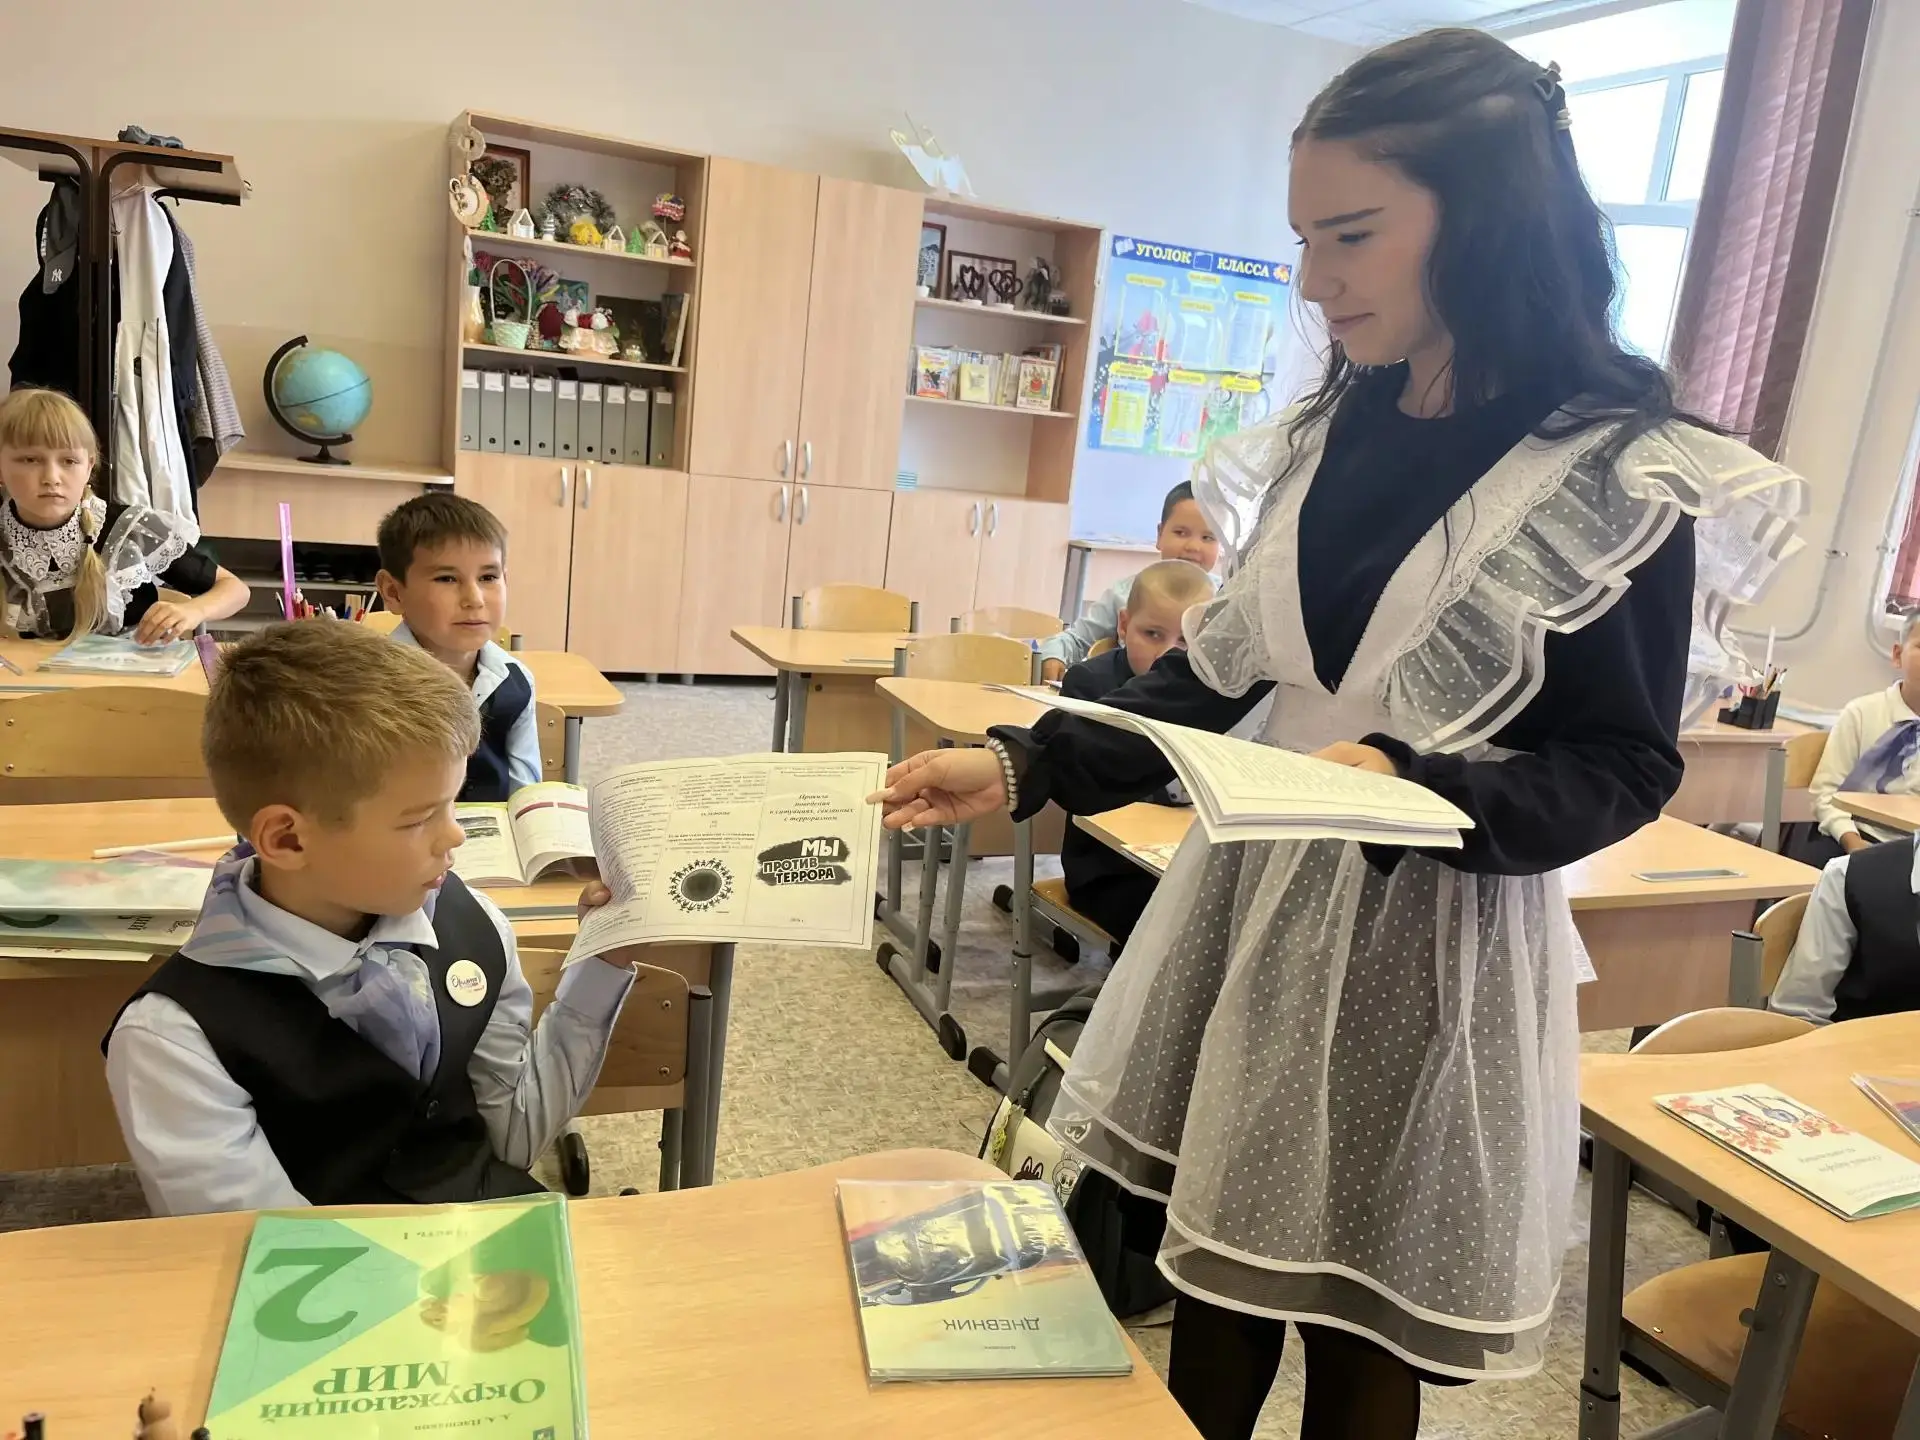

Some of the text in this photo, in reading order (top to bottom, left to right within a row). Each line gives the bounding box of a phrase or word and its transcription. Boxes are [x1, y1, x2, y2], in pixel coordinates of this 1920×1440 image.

[1136, 243, 1269, 277] УГОЛОК КЛАССА
[801, 839, 840, 857] МЫ
[763, 857, 819, 874] ПРОТИВ
[776, 867, 835, 884] ТЕРРОРА
[253, 1246, 370, 1343] 2
[943, 1317, 1040, 1332] ДНЕВНИК
[313, 1361, 449, 1396] МИР
[259, 1378, 546, 1423] Окружающий
